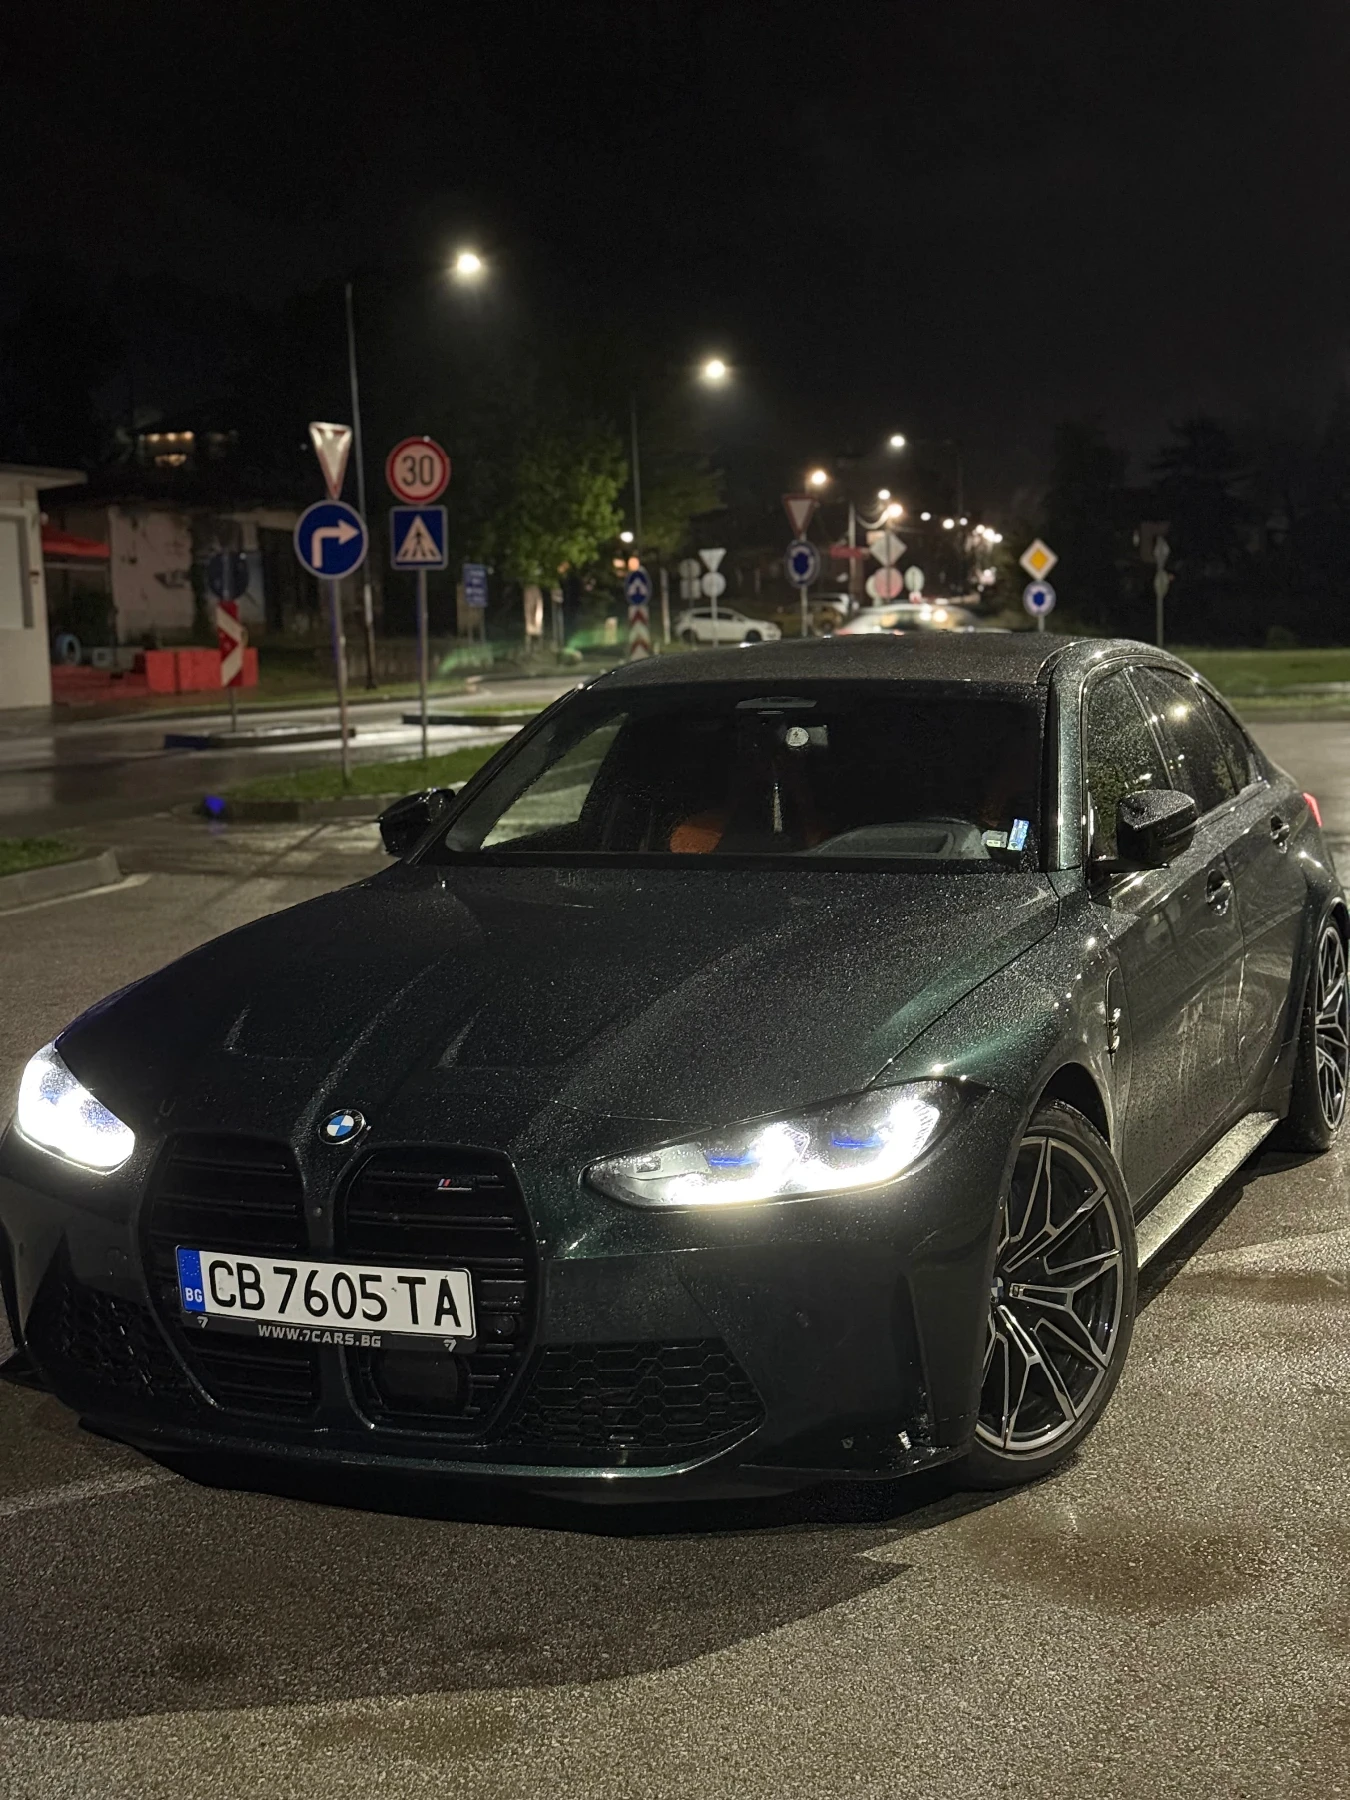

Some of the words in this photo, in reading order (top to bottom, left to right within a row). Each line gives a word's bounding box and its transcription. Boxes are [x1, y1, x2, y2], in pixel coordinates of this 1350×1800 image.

[402, 454, 434, 487] 30
[184, 1287, 203, 1303] BG
[208, 1259, 266, 1311] CB
[273, 1266, 388, 1322] 7605
[397, 1275, 462, 1328] TA
[257, 1324, 382, 1348] WWW.7CARS.BG
